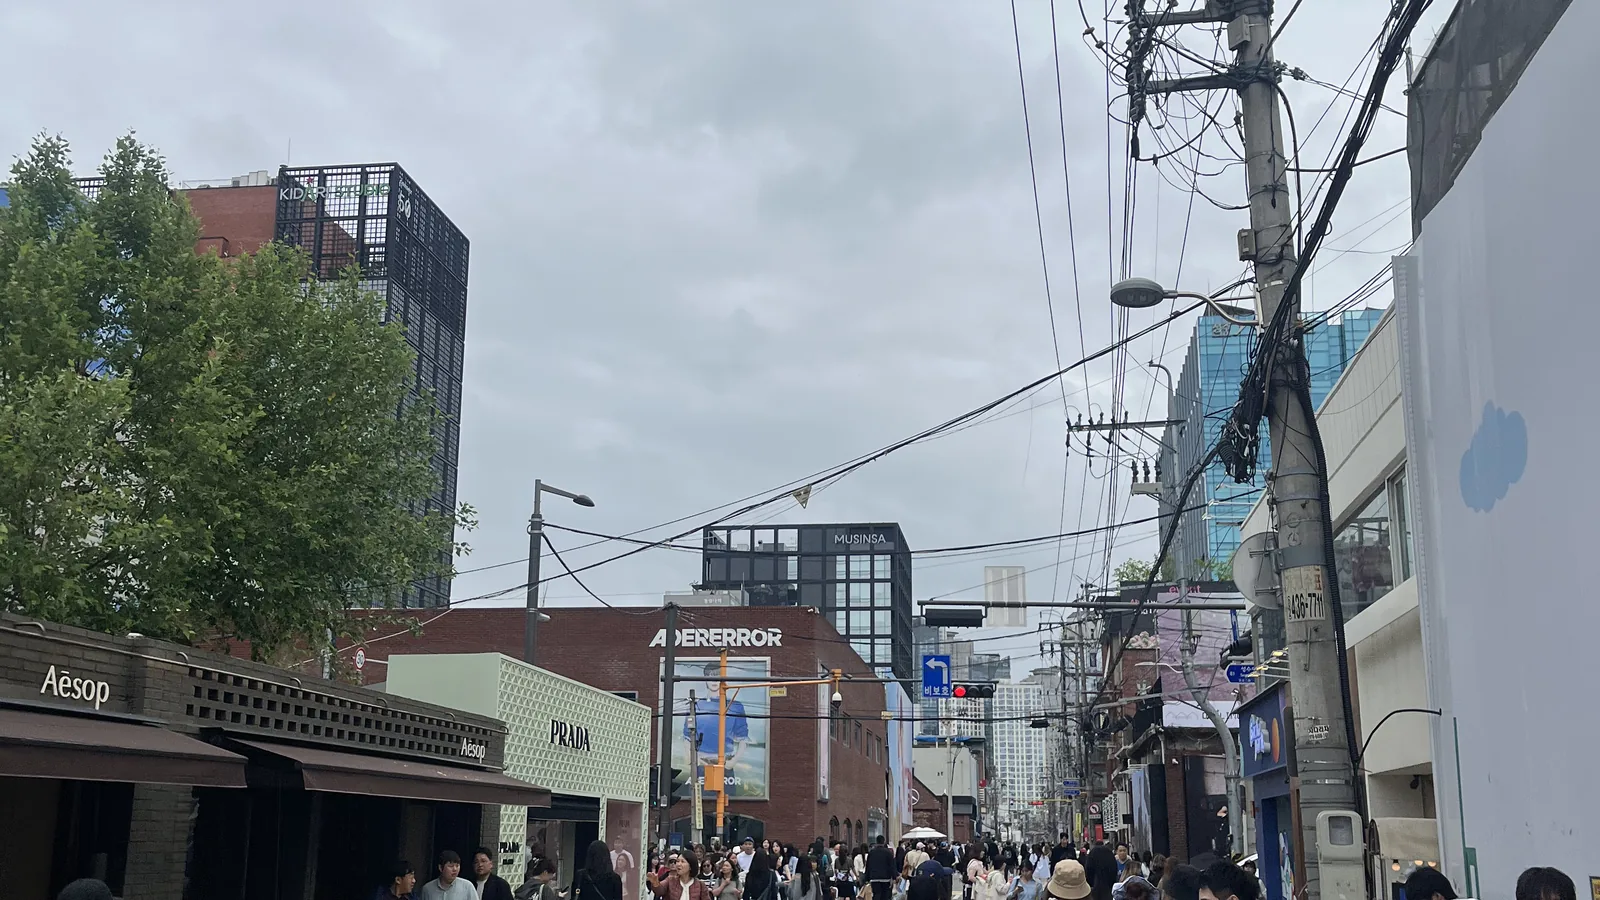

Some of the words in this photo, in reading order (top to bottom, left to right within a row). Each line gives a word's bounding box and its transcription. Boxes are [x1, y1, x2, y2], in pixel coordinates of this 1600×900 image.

[834, 533, 886, 544] MUSINSA
[1291, 593, 1324, 619] 436-7711
[924, 685, 950, 695] 비보호
[550, 719, 590, 752] PRADA
